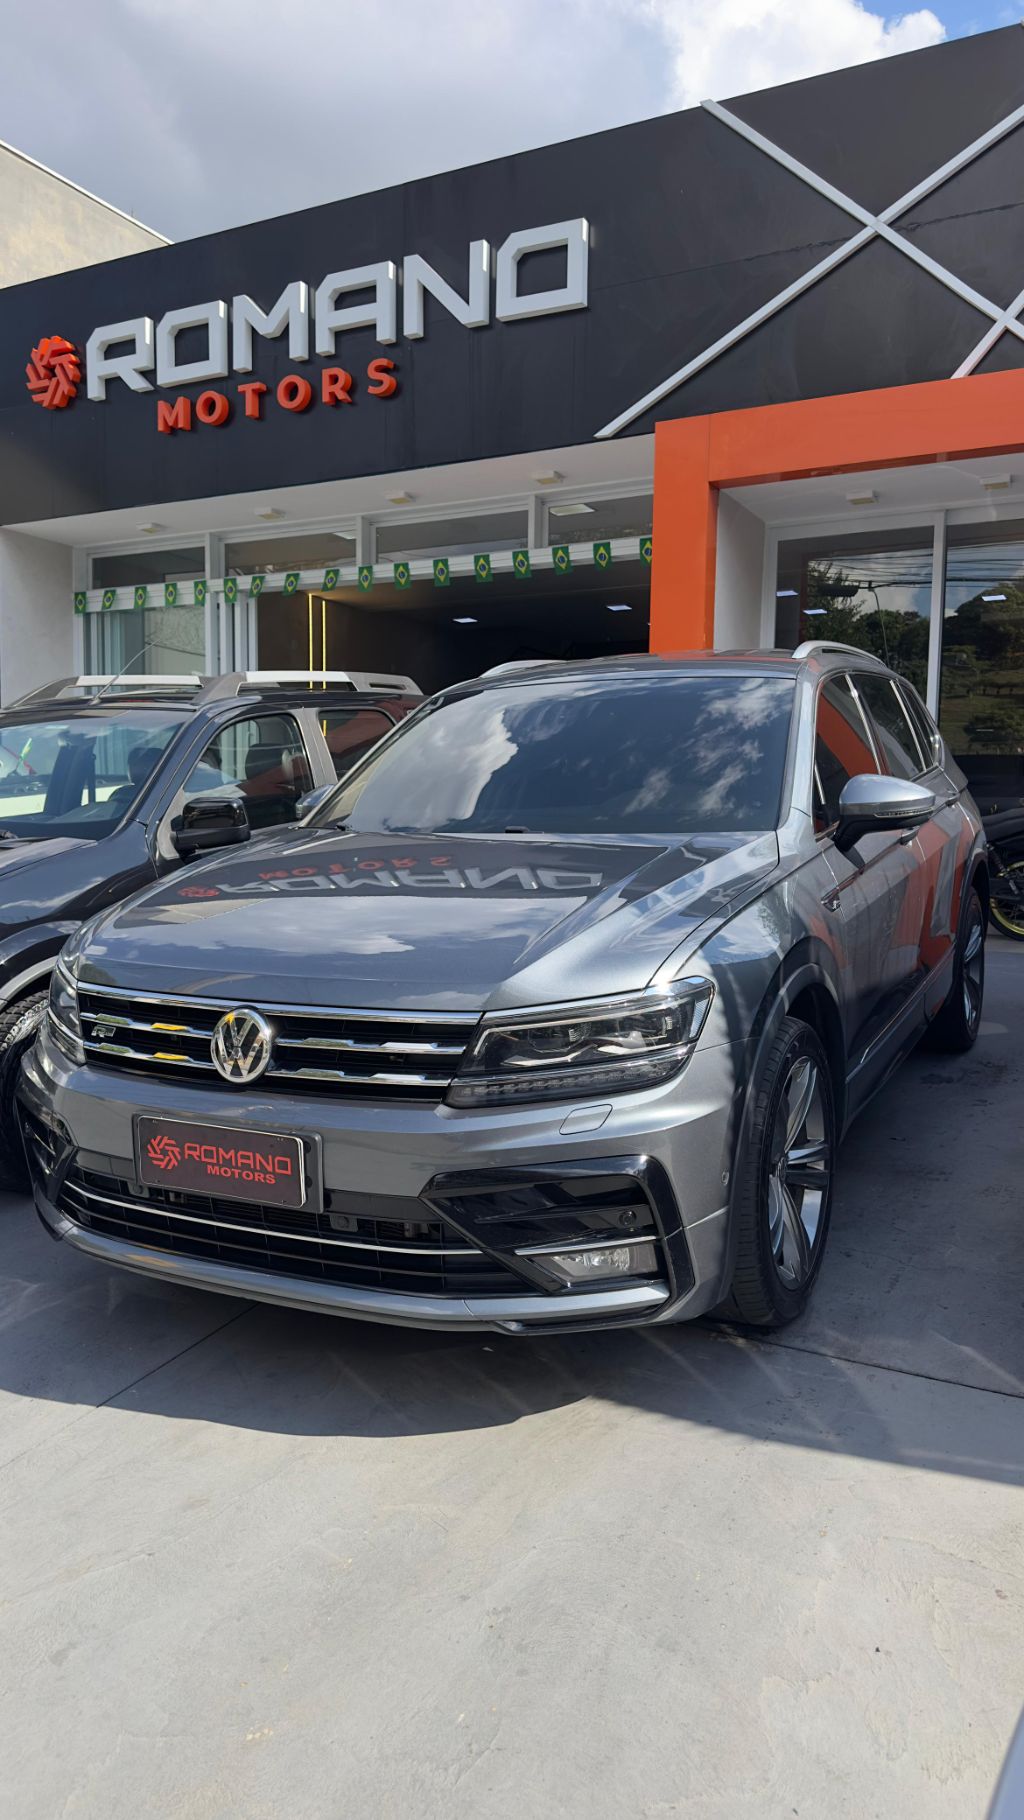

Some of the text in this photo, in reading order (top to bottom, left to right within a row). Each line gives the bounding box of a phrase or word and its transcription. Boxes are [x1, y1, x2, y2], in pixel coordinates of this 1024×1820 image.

[86, 217, 589, 401] ROMANO
[157, 358, 398, 433] MOTORS
[184, 1142, 292, 1175] ROMANO
[207, 1165, 276, 1184] MOTORS
